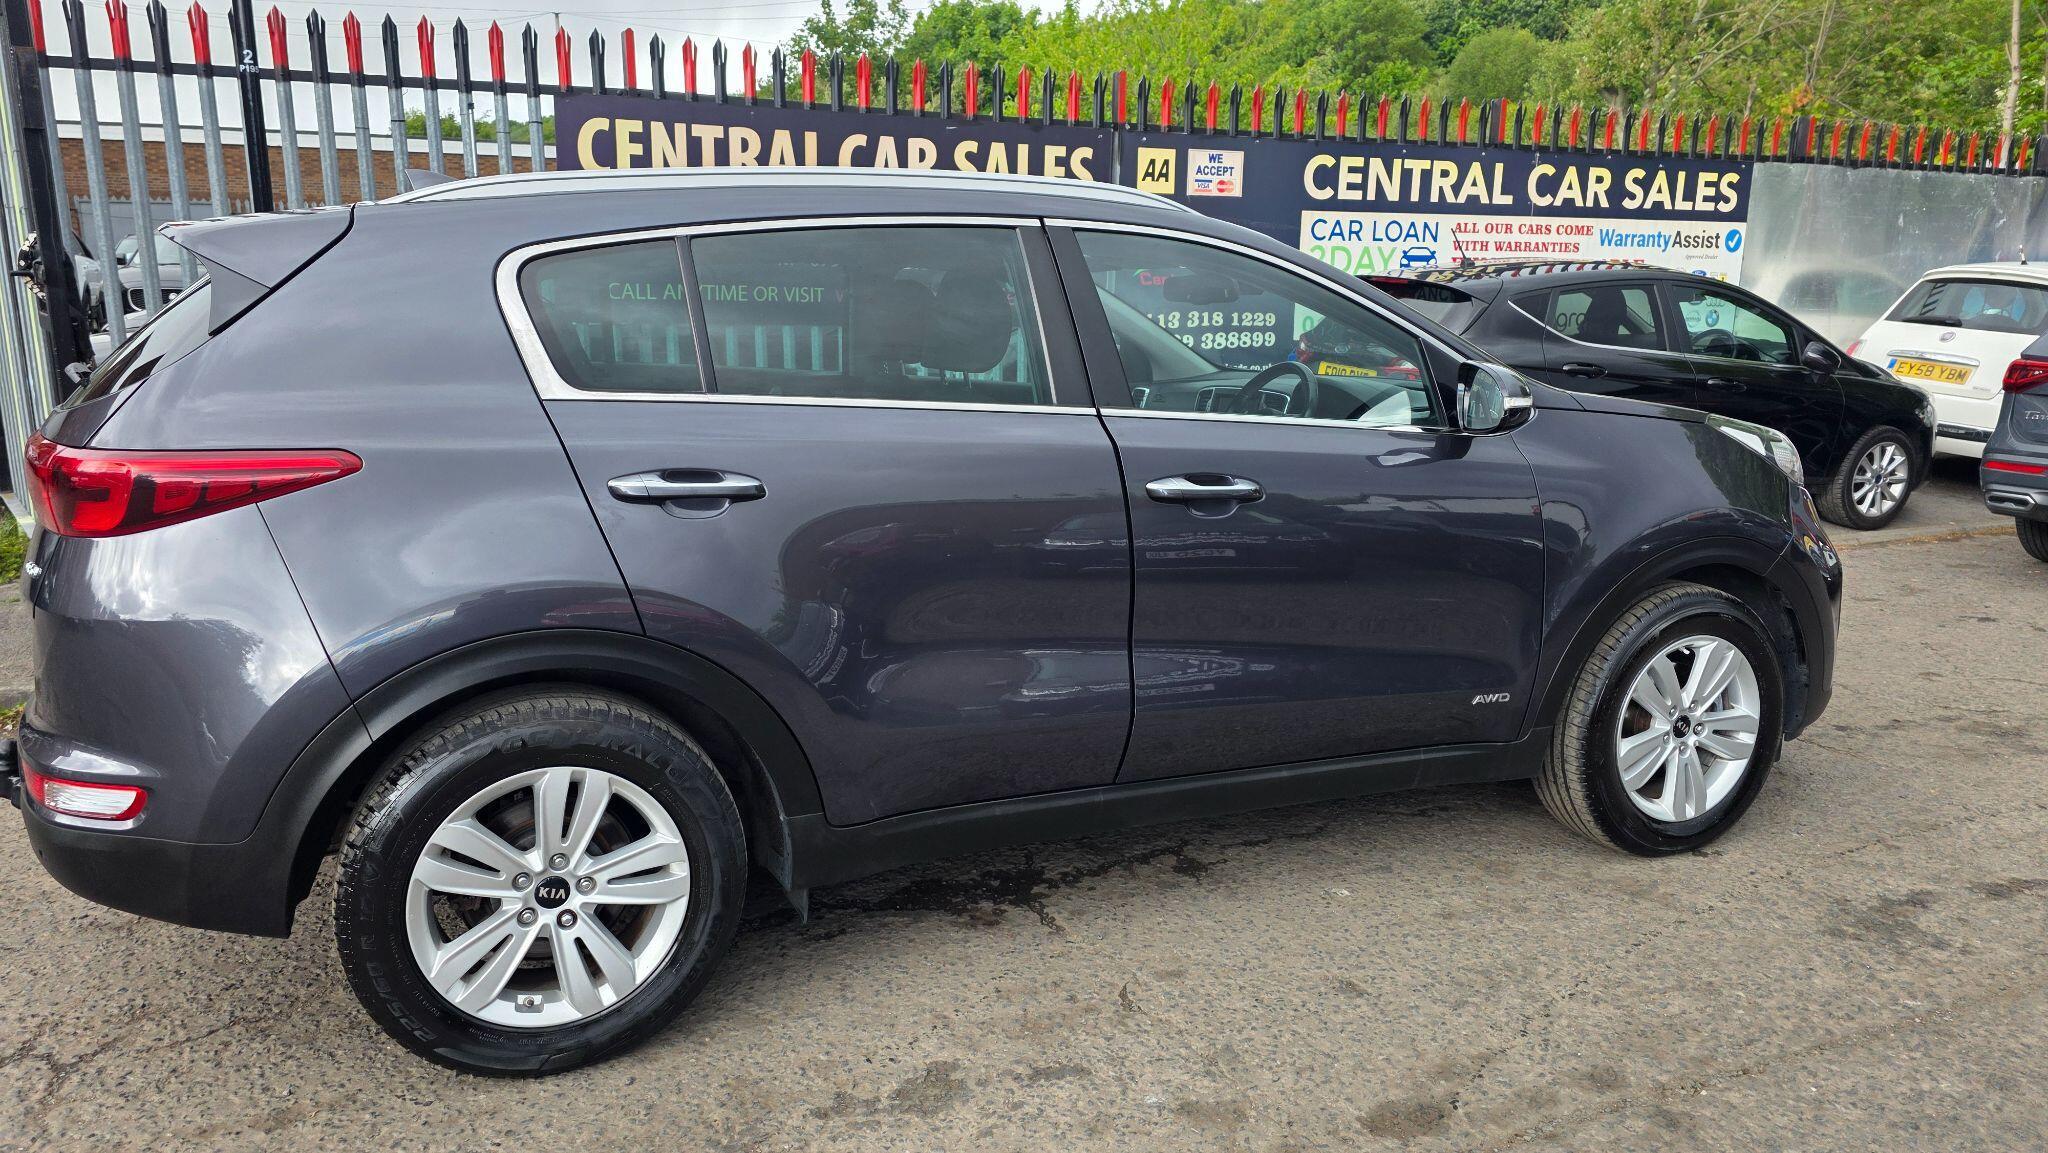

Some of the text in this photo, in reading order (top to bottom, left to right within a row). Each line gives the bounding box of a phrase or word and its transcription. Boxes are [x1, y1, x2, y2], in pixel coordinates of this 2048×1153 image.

[243, 49, 254, 64] 2
[1208, 153, 1223, 164] WE
[1141, 159, 1170, 182] AA
[1195, 165, 1235, 177] ACCEPT
[1303, 154, 1741, 213] CENTRAL CAR SALES
[1310, 218, 1439, 243] CAR LOAN
[1454, 222, 1594, 236] ALL OUR CARS COME
[1453, 240, 1580, 253] WITH WARRANTIES
[608, 282, 657, 300] CALL
[753, 286, 778, 302] OR
[784, 287, 825, 303] VISIT
[1187, 310, 1224, 328] 318
[1231, 312, 1276, 327] 1229
[1201, 331, 1276, 350] 388899
[1896, 361, 1968, 382] EY58 YBM
[1472, 692, 1510, 705] AWD
[1676, 721, 1689, 735] KIA
[538, 886, 566, 900] KIA
